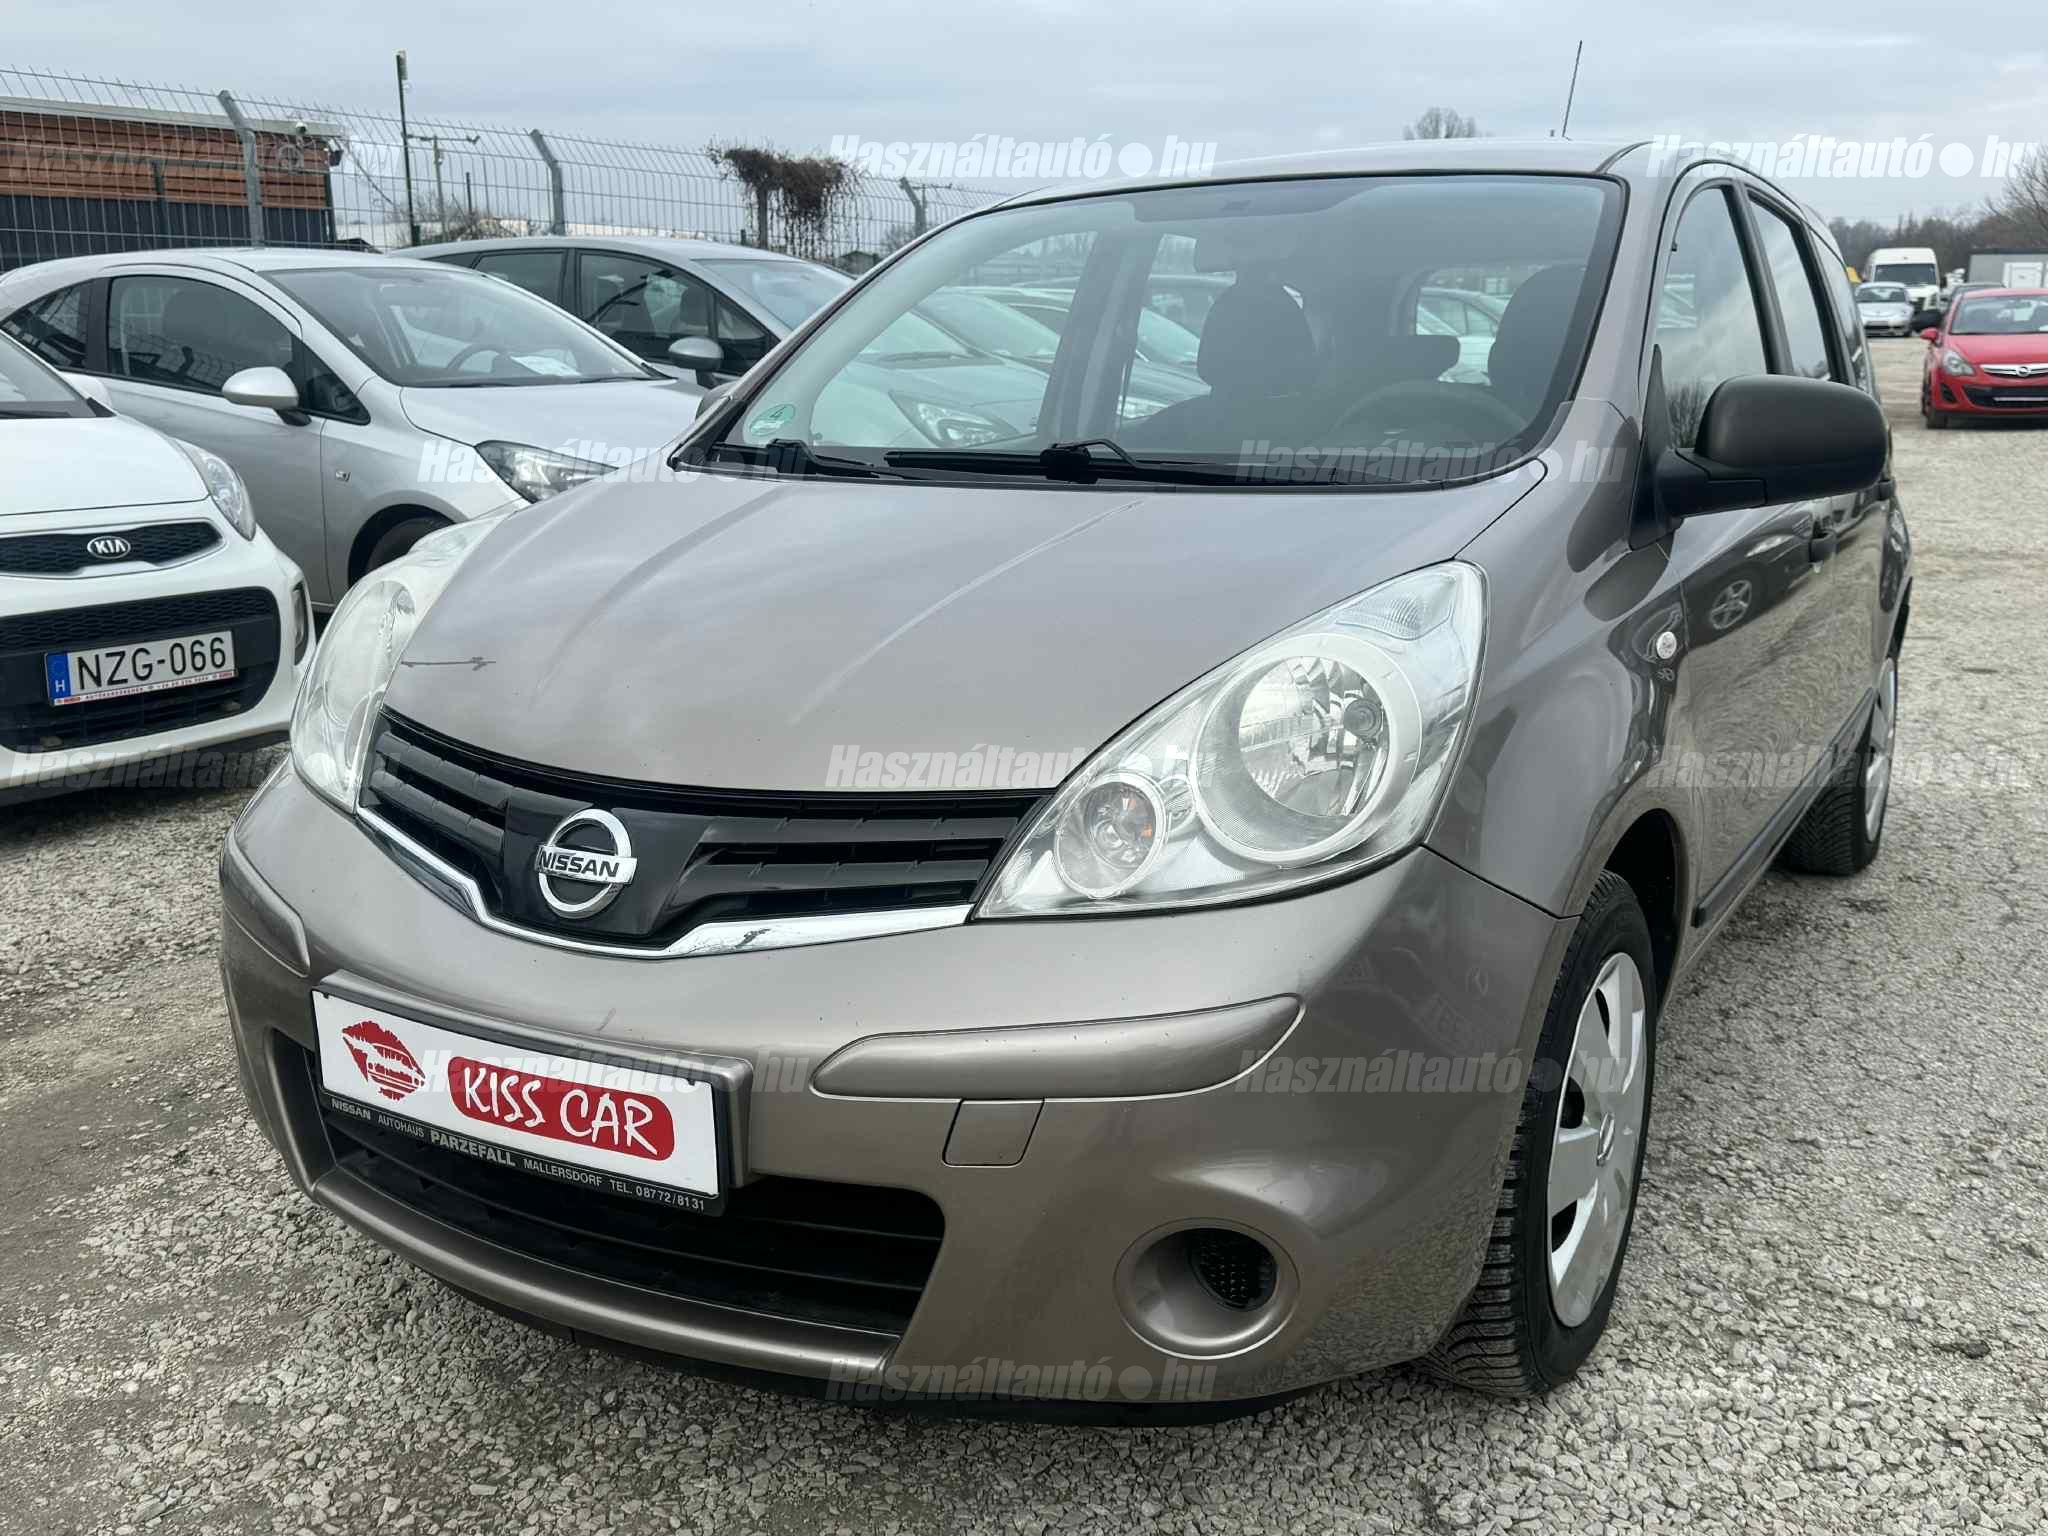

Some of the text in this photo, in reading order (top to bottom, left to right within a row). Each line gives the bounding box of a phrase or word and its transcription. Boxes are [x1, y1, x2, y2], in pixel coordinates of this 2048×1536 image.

[94, 538, 126, 554] KIA
[77, 636, 226, 691] NZG-066
[54, 679, 66, 694] H
[540, 850, 620, 878] NISSAN
[463, 1067, 659, 1156] KISS CAR
[331, 1098, 371, 1120] NISSAN
[378, 1114, 425, 1138] AUTOHAUS
[430, 1129, 516, 1167] PARZEFALL
[523, 1158, 603, 1187] MALLERSDORF
[609, 1179, 632, 1194] TEL.
